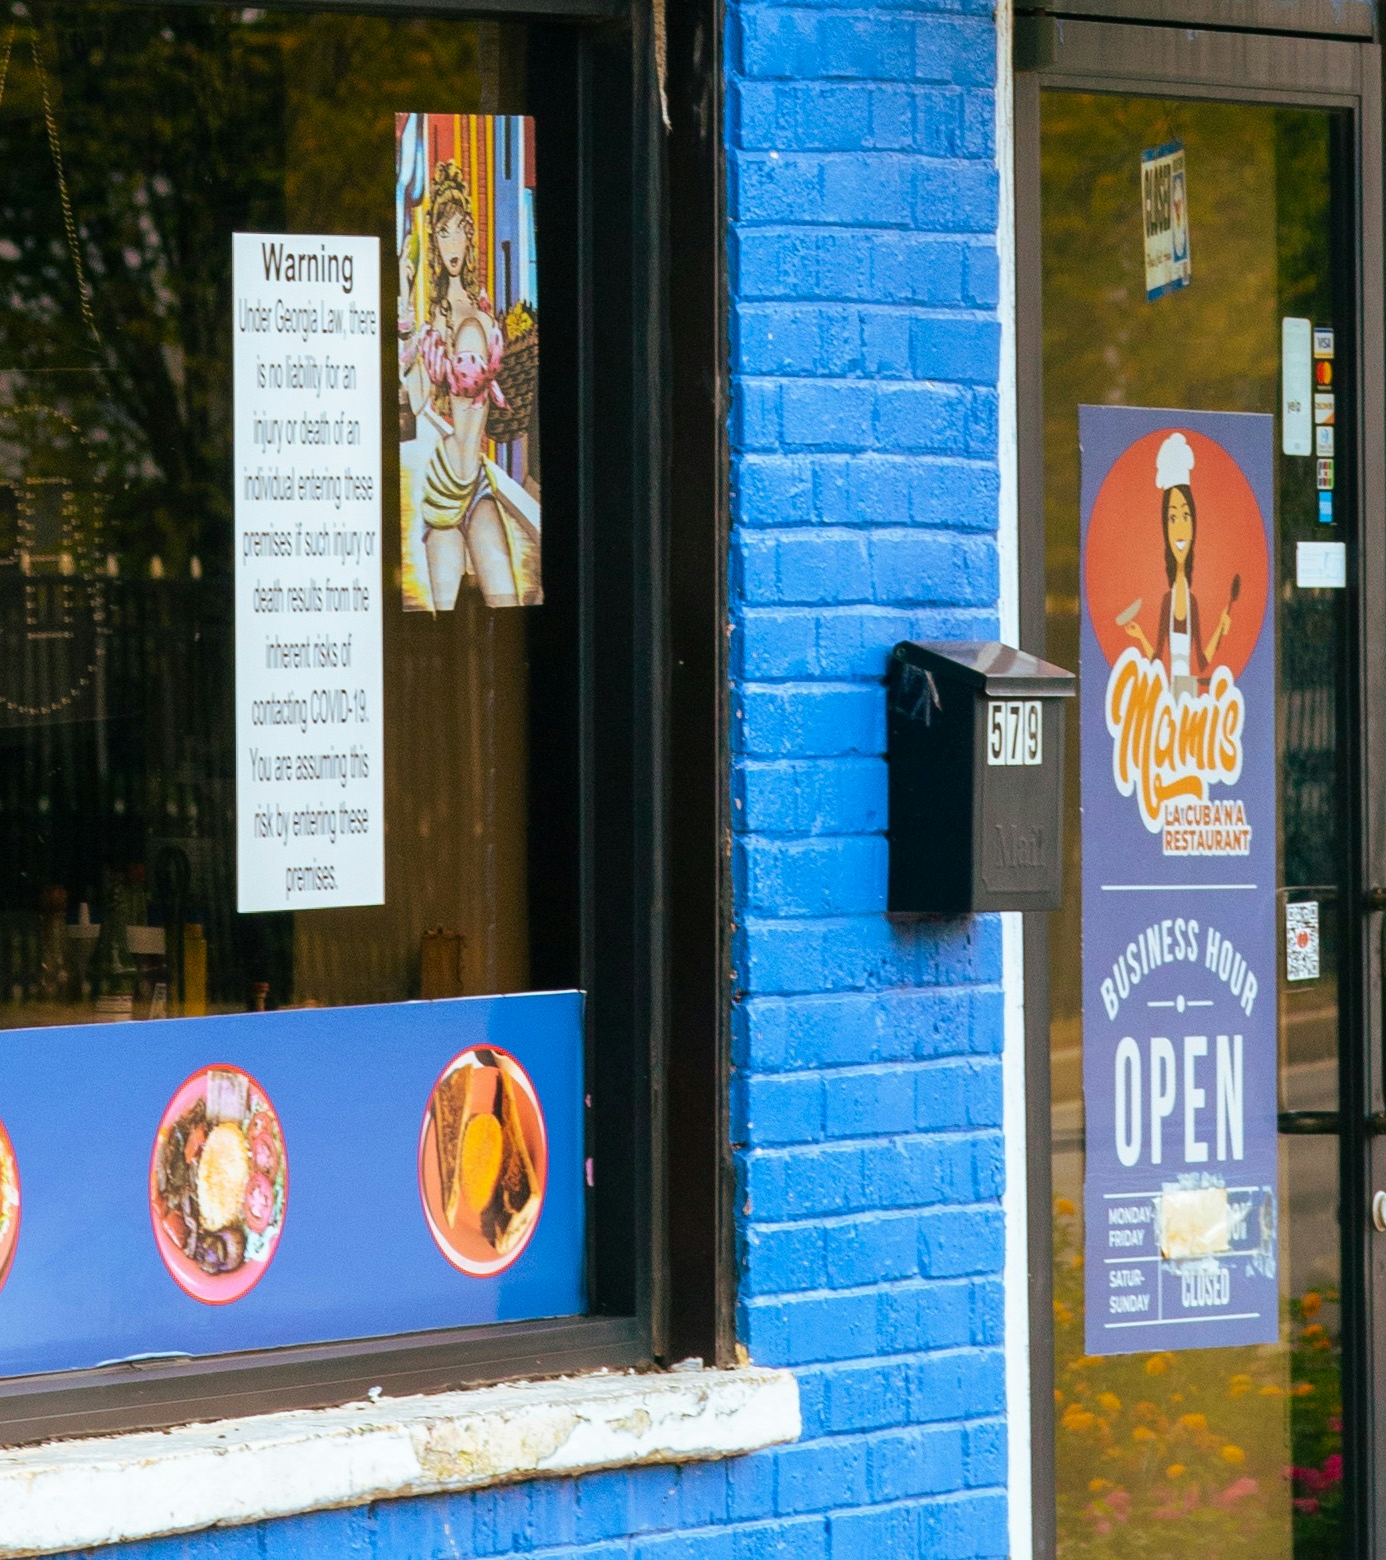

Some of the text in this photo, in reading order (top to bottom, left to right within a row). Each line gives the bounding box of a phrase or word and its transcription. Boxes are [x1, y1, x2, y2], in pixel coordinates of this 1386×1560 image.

[262, 242, 353, 294] Warning
[238, 298, 376, 341] Under Georgia Law, there
[257, 355, 356, 398] is no liability for an
[253, 411, 360, 453] injury or death of an
[244, 466, 373, 509] individual entering these
[243, 523, 292, 565] premises
[305, 523, 330, 557] such
[333, 523, 361, 565] injury
[365, 531, 375, 557] or
[253, 578, 369, 613] death results from the
[266, 633, 352, 668] inherent risks of
[311, 689, 369, 724] COVID-19.
[991, 704, 1039, 760] 579
[249, 745, 369, 787] You are assuming this
[254, 801, 369, 846] risk by entering these
[1165, 803, 1245, 827] LA CUBANA
[1165, 829, 1250, 852] RESTAURANT
[1100, 917, 1259, 1023] BUSINESS HOUR
[1114, 1034, 1245, 1168] OPEN
[1108, 1228, 1146, 1248] FRIDAY
[1109, 1268, 1146, 1288] SATUR-
[1181, 1267, 1231, 1308] CLOSED
[1109, 1293, 1151, 1314] SUNDAY
